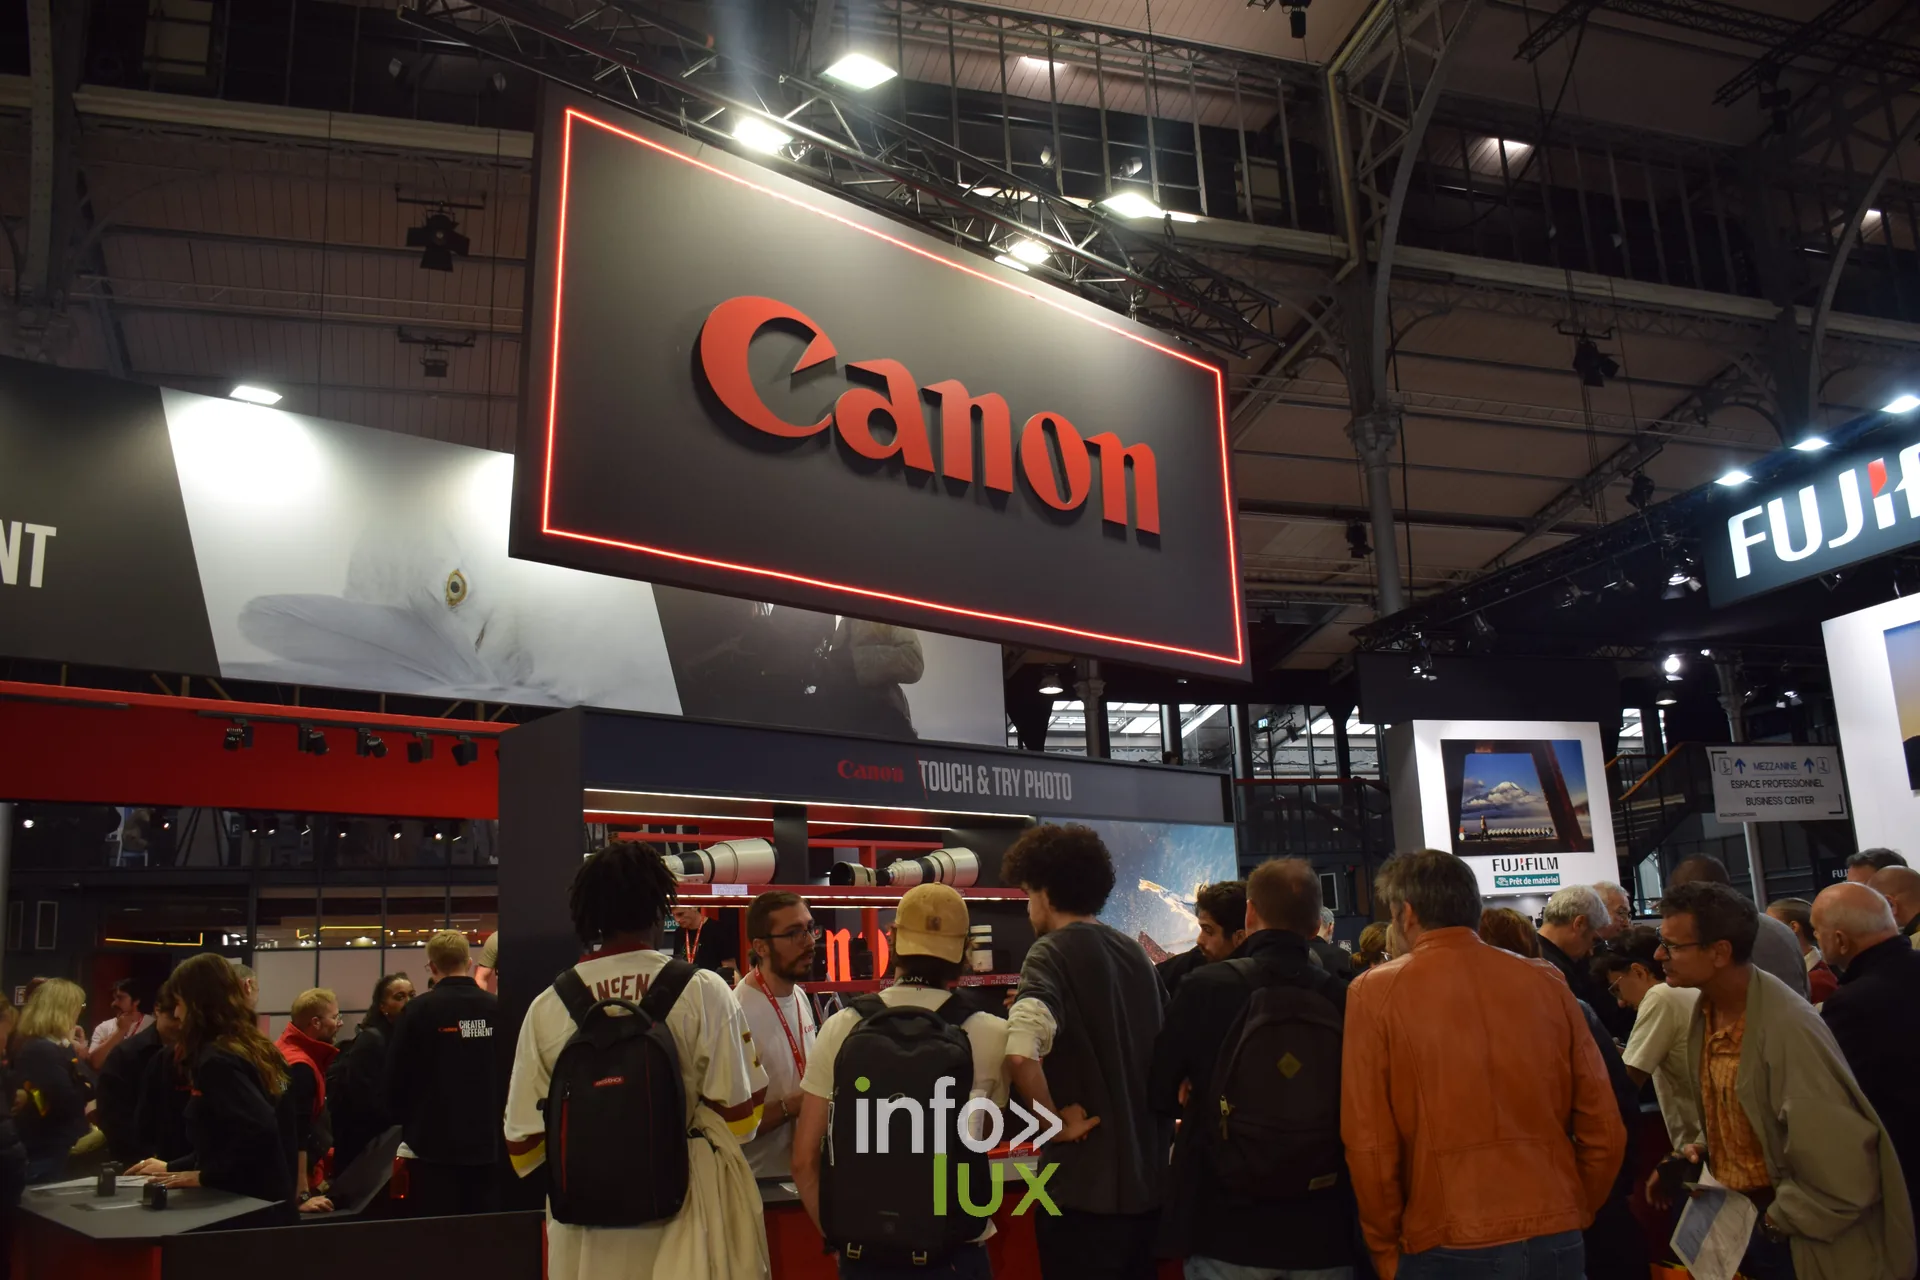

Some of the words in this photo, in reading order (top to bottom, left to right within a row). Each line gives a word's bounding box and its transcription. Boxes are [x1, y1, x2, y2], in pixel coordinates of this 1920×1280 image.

[700, 295, 1160, 534] Canon
[1752, 761, 1798, 771] MEZZANINE
[836, 759, 904, 783] Canon
[918, 760, 973, 794] TOUCH
[977, 765, 990, 795] &
[992, 766, 1021, 797] TRY
[1024, 769, 1073, 801] PHOTO
[1730, 780, 1761, 789] ESPACE
[1762, 778, 1824, 789] PROFESSIONNEL
[1745, 796, 1783, 806] BUSINESS
[1784, 795, 1815, 805] CENTER
[1492, 856, 1559, 872] FUJIFILM
[1508, 877, 1522, 885] Prêt
[1523, 875, 1532, 884] de
[1532, 875, 1559, 884] matériel
[459, 1019, 486, 1029] CREATED
[461, 1027, 493, 1038] DIFFERENT
